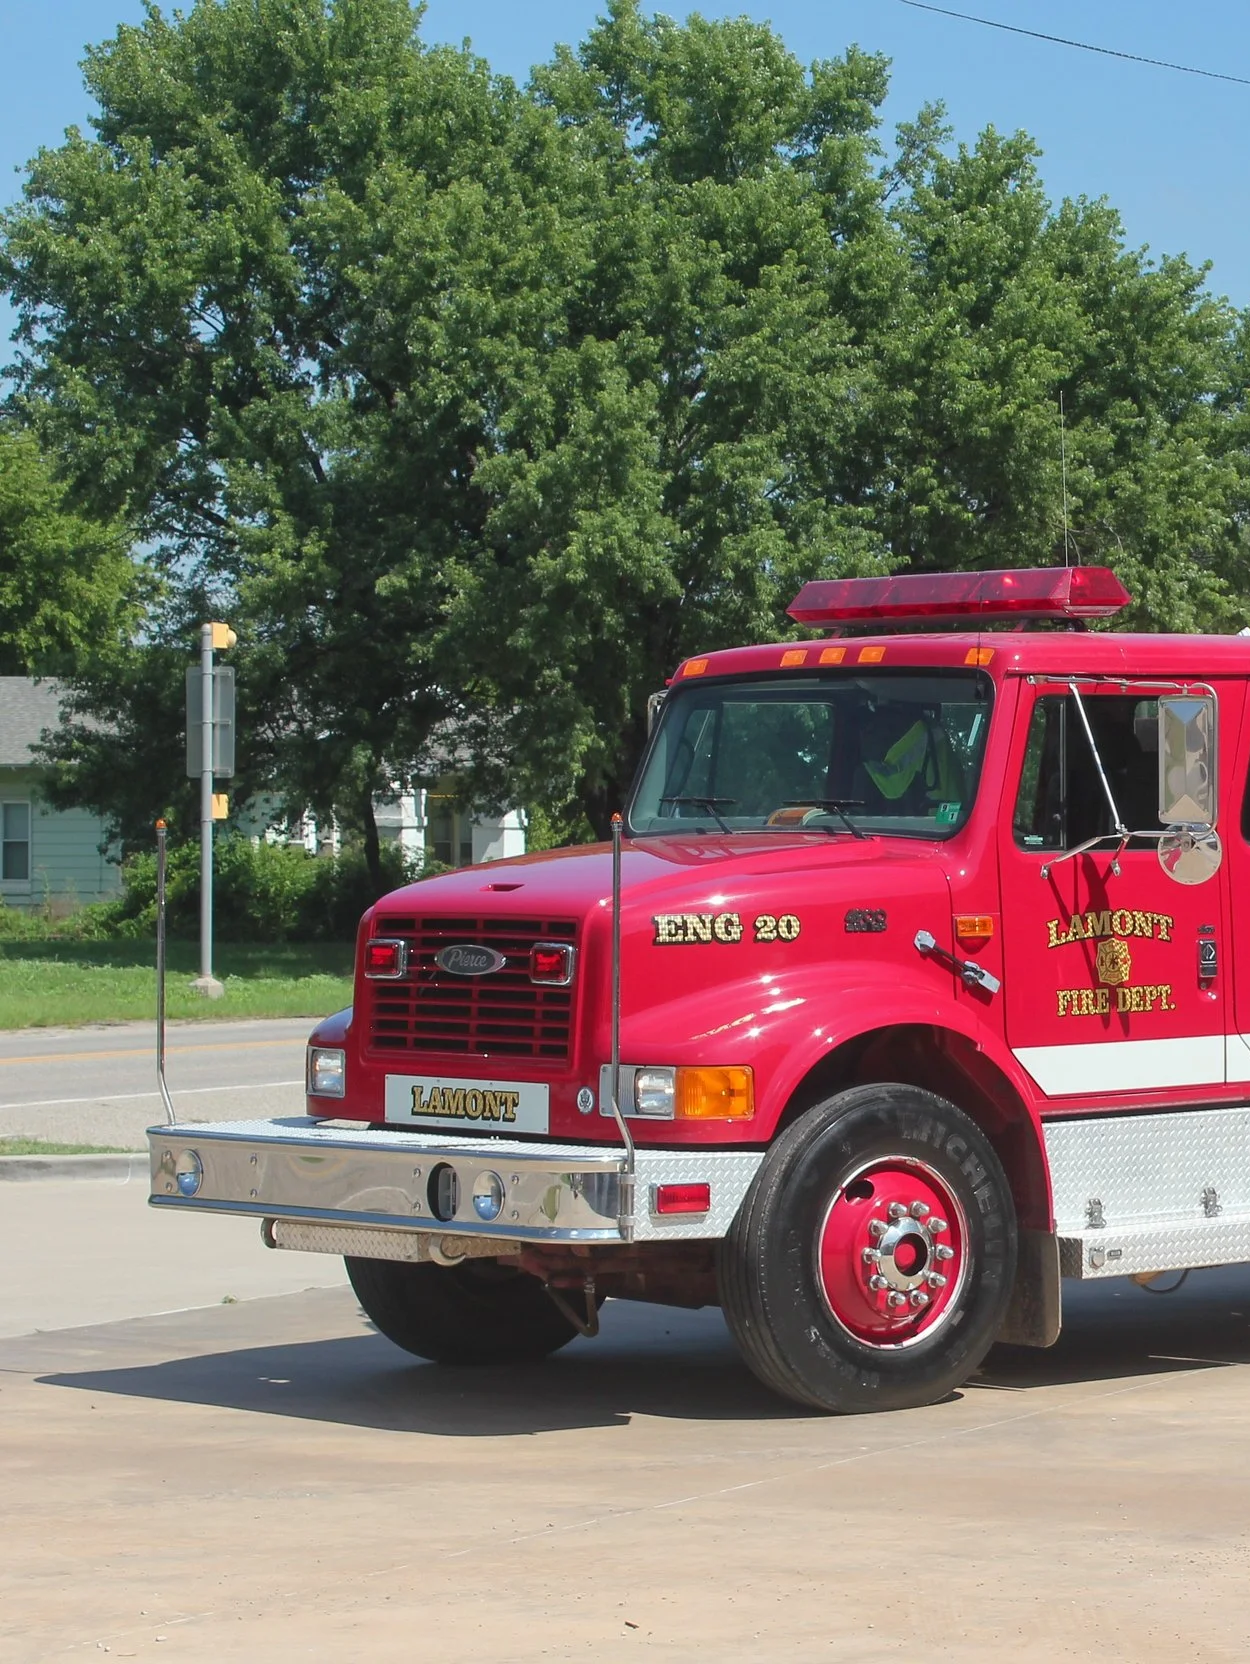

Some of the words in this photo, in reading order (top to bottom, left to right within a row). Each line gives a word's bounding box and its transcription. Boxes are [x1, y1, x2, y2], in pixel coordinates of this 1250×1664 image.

[653, 912, 744, 945] ENG
[754, 914, 801, 943] 20
[1046, 908, 1174, 948] LAMONT
[448, 948, 488, 969] Pierce
[1056, 986, 1110, 1017] FIRE
[1116, 984, 1177, 1014] DEPT.
[411, 1085, 519, 1122] LAMONT
